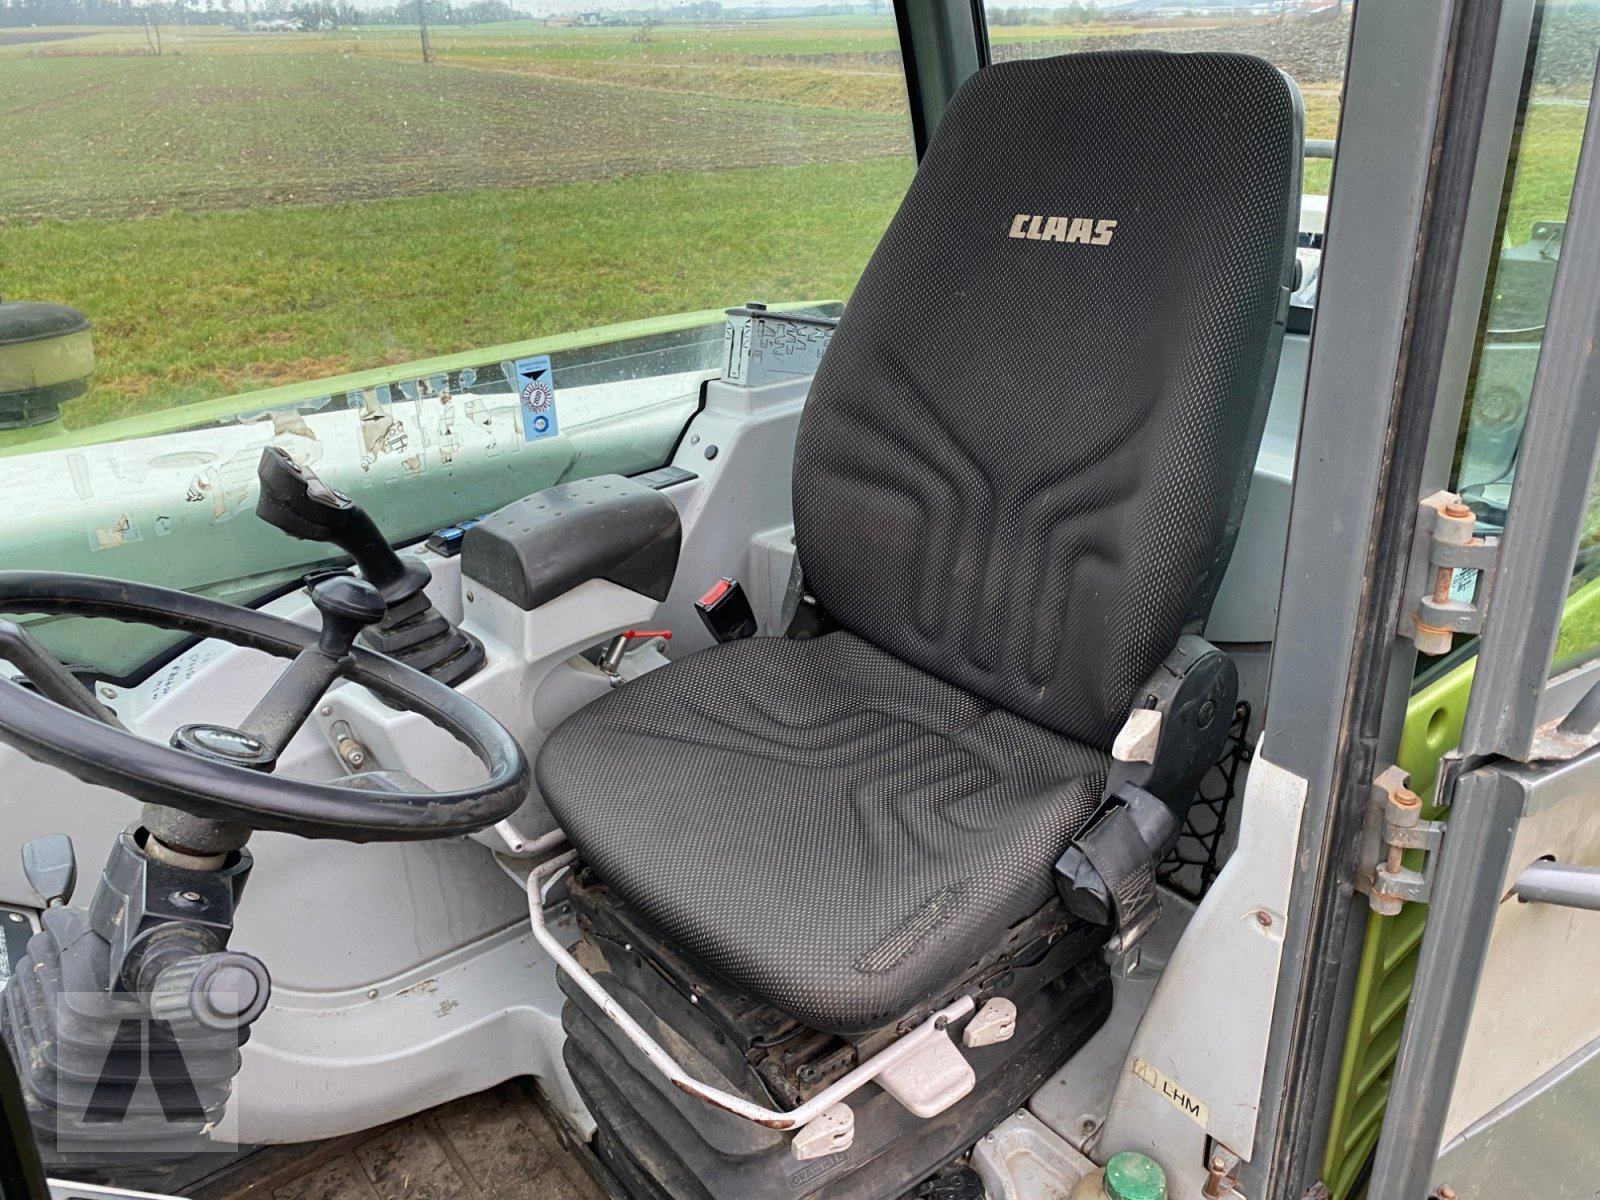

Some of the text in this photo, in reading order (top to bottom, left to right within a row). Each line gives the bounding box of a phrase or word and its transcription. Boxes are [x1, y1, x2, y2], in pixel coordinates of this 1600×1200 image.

[1008, 214, 1118, 245] CLAAS
[1163, 1080, 1200, 1117] LHM
[793, 1152, 846, 1184] GRAMMER
